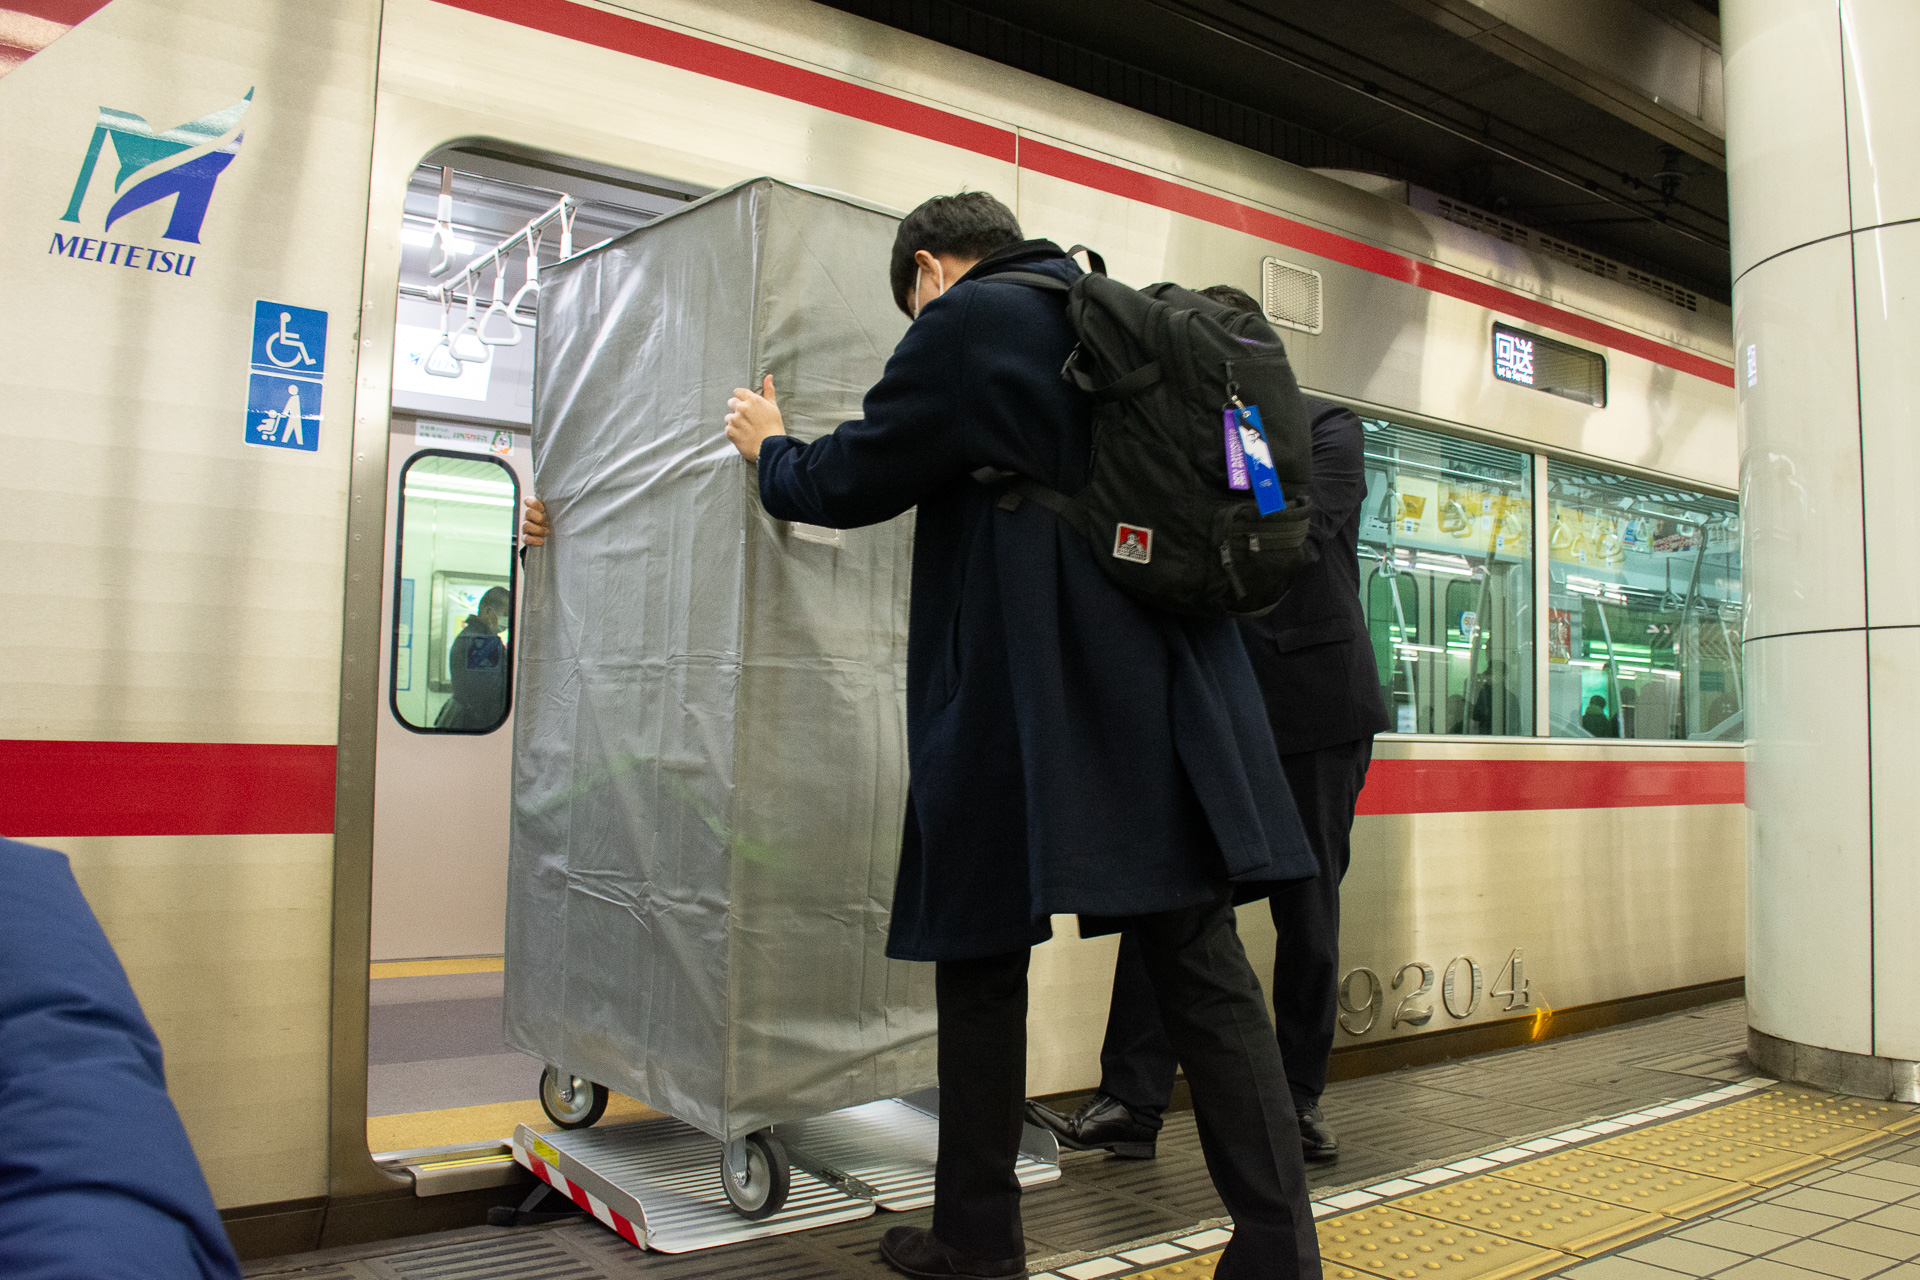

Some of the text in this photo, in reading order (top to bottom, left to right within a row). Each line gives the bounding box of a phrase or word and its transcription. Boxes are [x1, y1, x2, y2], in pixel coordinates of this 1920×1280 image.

[48, 232, 196, 277] MEITETSU
[1495, 332, 1534, 375] 回送
[1338, 947, 1530, 1036] 9204
